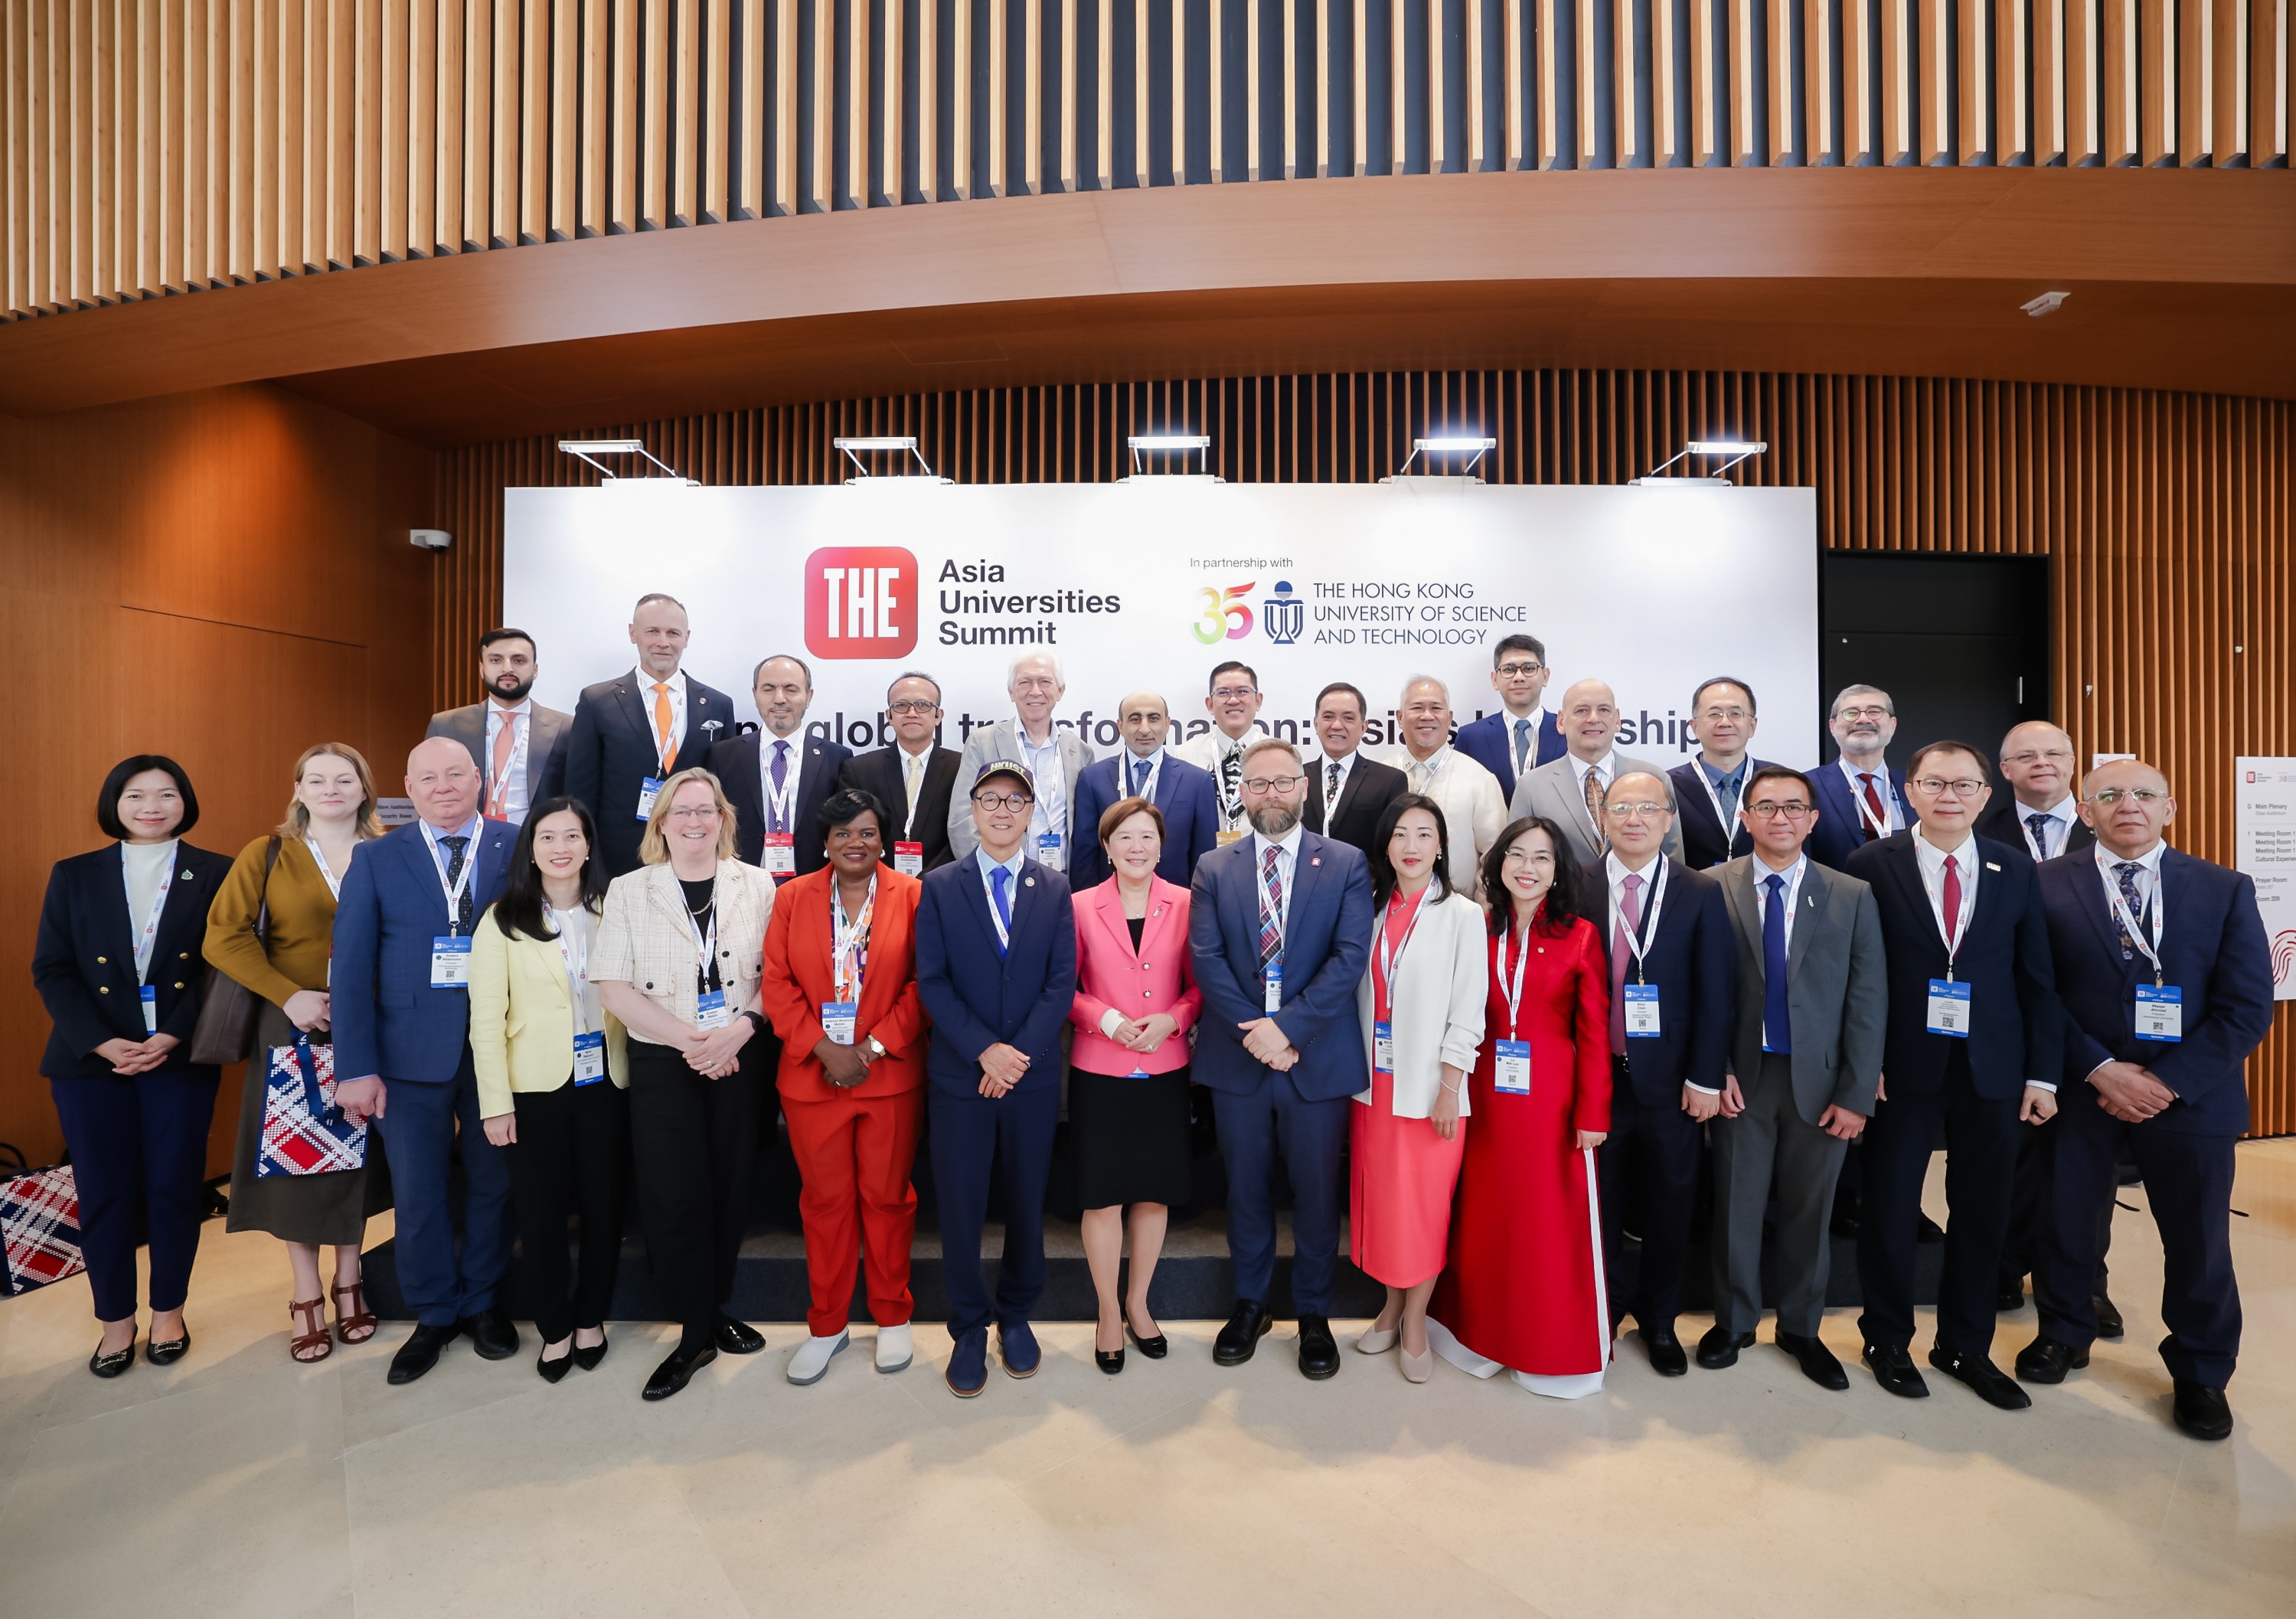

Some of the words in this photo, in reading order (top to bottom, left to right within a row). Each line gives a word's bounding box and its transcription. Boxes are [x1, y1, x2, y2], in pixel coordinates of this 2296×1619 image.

[939, 560, 1004, 583] Asia
[1191, 558, 1199, 567] In
[1204, 558, 1266, 570] partnership
[1270, 558, 1292, 567] with
[941, 589, 1120, 613] Universities
[1314, 583, 1344, 598] THE
[1353, 583, 1410, 598] HONG
[1418, 583, 1473, 598] KONG
[824, 568, 899, 638] THE
[1190, 581, 1256, 645] 35
[1315, 606, 1414, 621] UNIVERSITY
[1421, 606, 1445, 621] OF
[1452, 606, 1526, 622] SCIENCE
[939, 621, 1056, 645] Summit
[1315, 629, 1355, 644] AND
[1362, 629, 1486, 644] TECHNOLOGY
[278, 1095, 294, 1109] LOVE
[322, 1131, 334, 1141] LOVE
[332, 1141, 346, 1152] HONG
[345, 1151, 358, 1160] KONG
